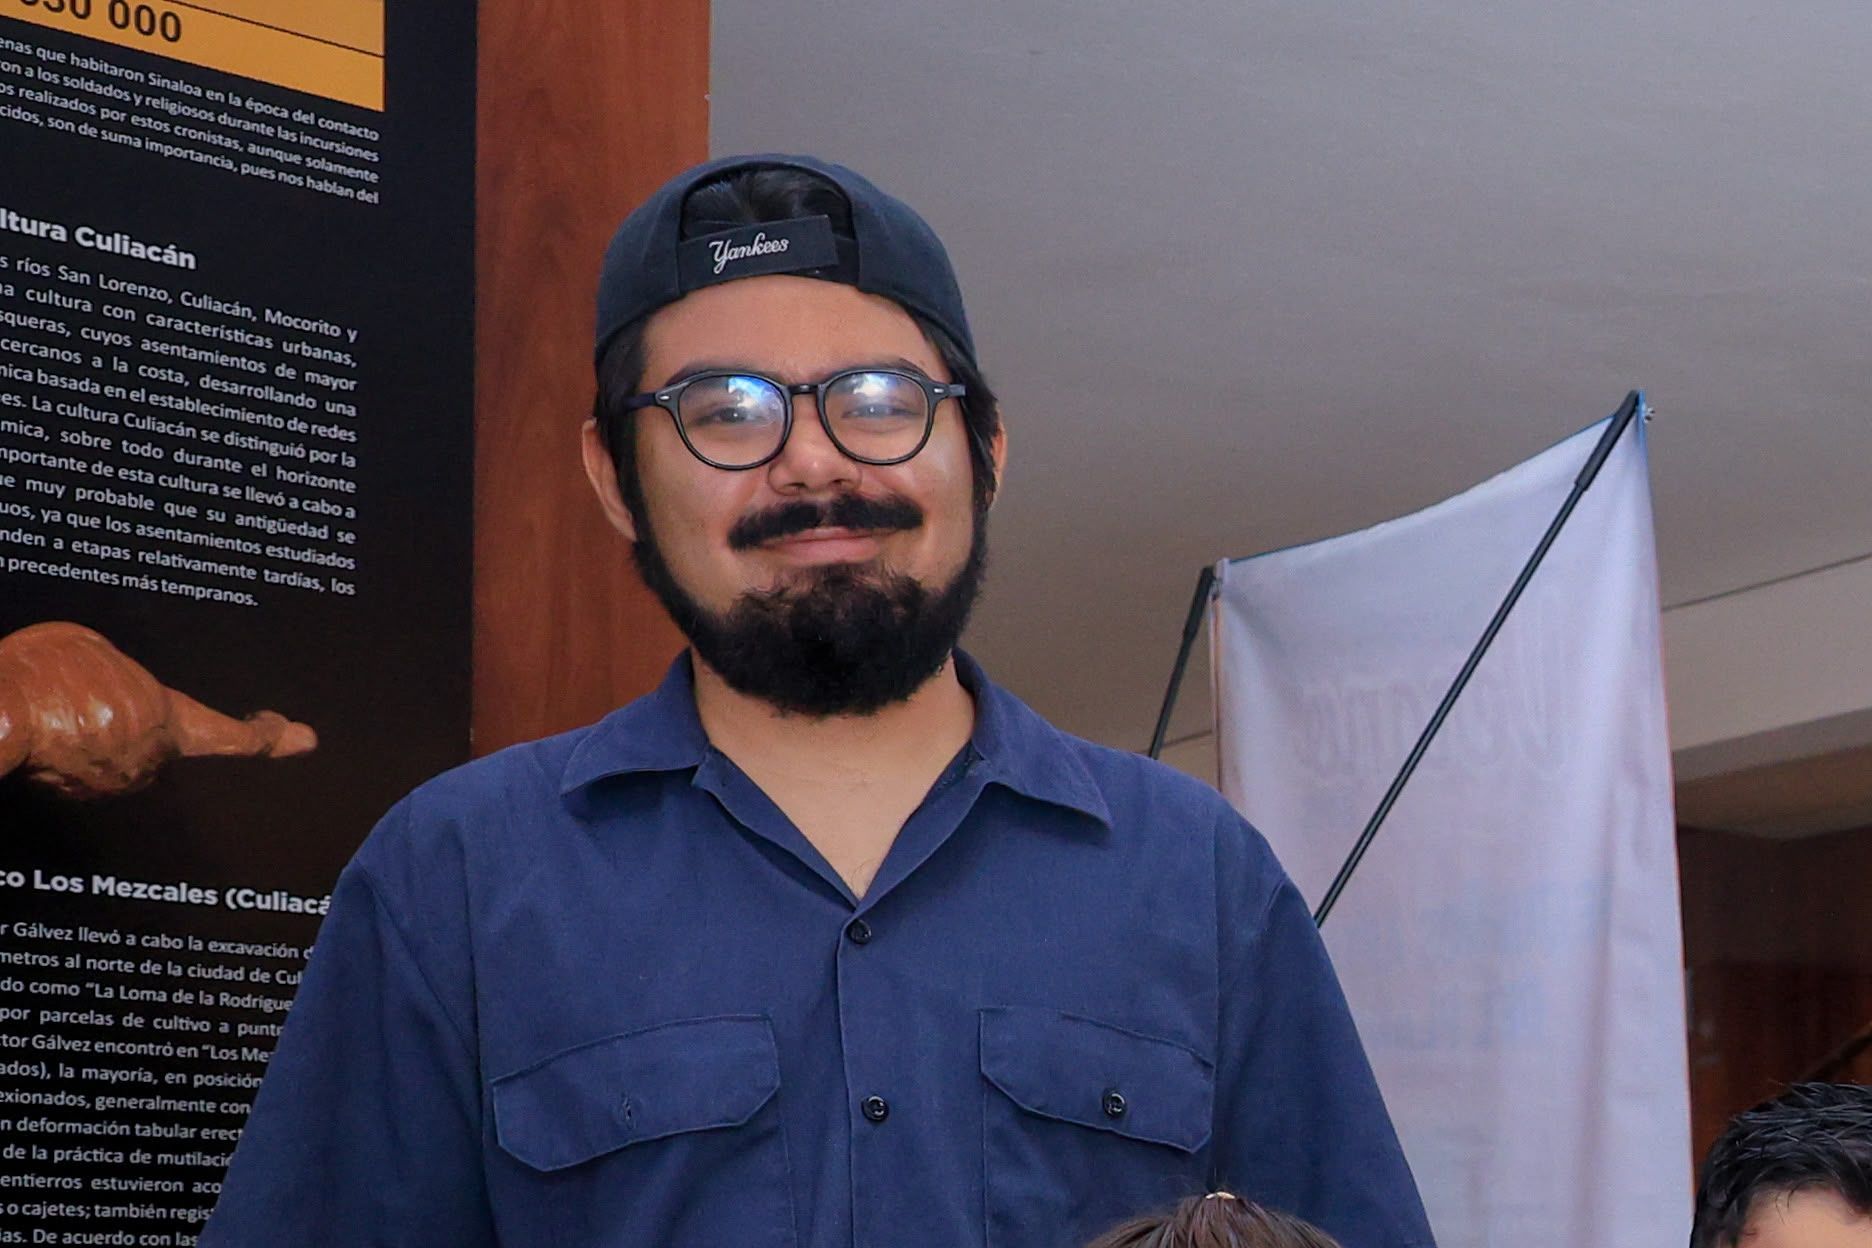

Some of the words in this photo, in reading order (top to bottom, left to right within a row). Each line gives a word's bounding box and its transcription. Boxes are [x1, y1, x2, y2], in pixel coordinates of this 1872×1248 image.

[108, 0, 182, 43] 000
[36, 47, 66, 63] que
[70, 52, 144, 82] habitaron
[148, 72, 202, 97] Sinaloa
[244, 96, 289, 118] época
[291, 109, 315, 124] del
[317, 117, 379, 141] contacto
[37, 66, 60, 84] los
[62, 75, 131, 101] soldados
[145, 96, 215, 122] religiosos
[217, 112, 275, 137] durante
[277, 125, 298, 142] las
[299, 131, 379, 162] incursiones
[18, 87, 96, 115] realizados
[100, 107, 127, 122] por
[130, 114, 171, 133] estos
[173, 125, 243, 152] cronistas,
[247, 142, 303, 164] aunque
[304, 156, 379, 183] solamente
[47, 117, 75, 132] son
[100, 129, 142, 148] suma
[240, 162, 276, 180] pues
[277, 171, 304, 186] nos
[306, 175, 354, 198] hablan
[356, 188, 379, 204] del
[74, 226, 195, 269] Culiacán
[708, 232, 790, 274] Yankees
[16, 257, 50, 277] ríos
[57, 265, 90, 285] San
[99, 273, 173, 304] Lorenzo,
[180, 291, 257, 321] Culiacán,
[264, 308, 341, 337] Mocorito
[25, 288, 92, 312] cultura
[102, 304, 136, 321] con
[145, 313, 273, 348] características
[282, 341, 357, 367] urbanas,
[0, 338, 82, 364] cercanos
[138, 365, 189, 386] costa,
[199, 374, 317, 408] desarrollando
[325, 400, 356, 417] una
[80, 327, 132, 347] cuyos
[140, 338, 266, 373] asentamientos
[304, 371, 357, 390] mayor
[37, 368, 100, 394] basada
[148, 393, 284, 428] establecimiento
[310, 424, 357, 442] redes
[56, 402, 119, 424] cultura
[123, 412, 196, 438] Culiacán
[223, 431, 306, 458] distinguió
[309, 449, 338, 463] por
[60, 430, 112, 450] sobre
[121, 439, 164, 459] todo
[173, 447, 242, 473] durante
[276, 465, 356, 493] horizonte
[25, 479, 66, 498] muy
[75, 487, 155, 510] probable
[163, 502, 197, 518] que
[234, 513, 328, 539] antigüedad
[117, 467, 154, 484] esta
[158, 474, 219, 495] cultura
[245, 485, 285, 506] llevó
[301, 498, 342, 516] cabo
[40, 508, 61, 523] ya
[66, 512, 101, 528] que
[105, 515, 131, 533] los
[135, 524, 261, 554] asentamientos
[265, 545, 355, 569] estudiados
[8, 558, 120, 585] precedentes
[122, 574, 158, 591] más
[160, 579, 258, 606] tempranos.
[71, 540, 131, 560] etapas
[138, 550, 257, 579] relativamente
[263, 568, 325, 592] tardías,
[331, 577, 355, 595] los
[33, 869, 84, 893] Los
[92, 875, 218, 905] Mezcales
[13, 921, 73, 940] Gálvez
[78, 926, 121, 944] llevó
[140, 933, 183, 949] cabo
[207, 940, 299, 958] excavación
[29, 981, 80, 996] como
[119, 985, 167, 1002] Loma
[86, 958, 135, 973] norte
[187, 963, 245, 981] ciudad
[39, 1009, 114, 1026] parcelas
[152, 1015, 211, 1032] cultivo
[31, 1033, 91, 1052] Gálvez
[93, 1041, 174, 1056] encontró
[81, 1067, 158, 1084] mayoría,
[15, 1116, 130, 1135] deformación
[134, 1122, 197, 1138] tabular
[95, 1095, 216, 1113] generalmente
[219, 1101, 252, 1114] con
[53, 1146, 124, 1163] práctica
[0, 1173, 82, 1189] entierros
[90, 1176, 184, 1192] estuvieron
[21, 1200, 91, 1219] cajetes;
[93, 1202, 167, 1218] también
[32, 1228, 57, 1244] De
[61, 1230, 135, 1246] acuerdo
[138, 1234, 171, 1246] con
